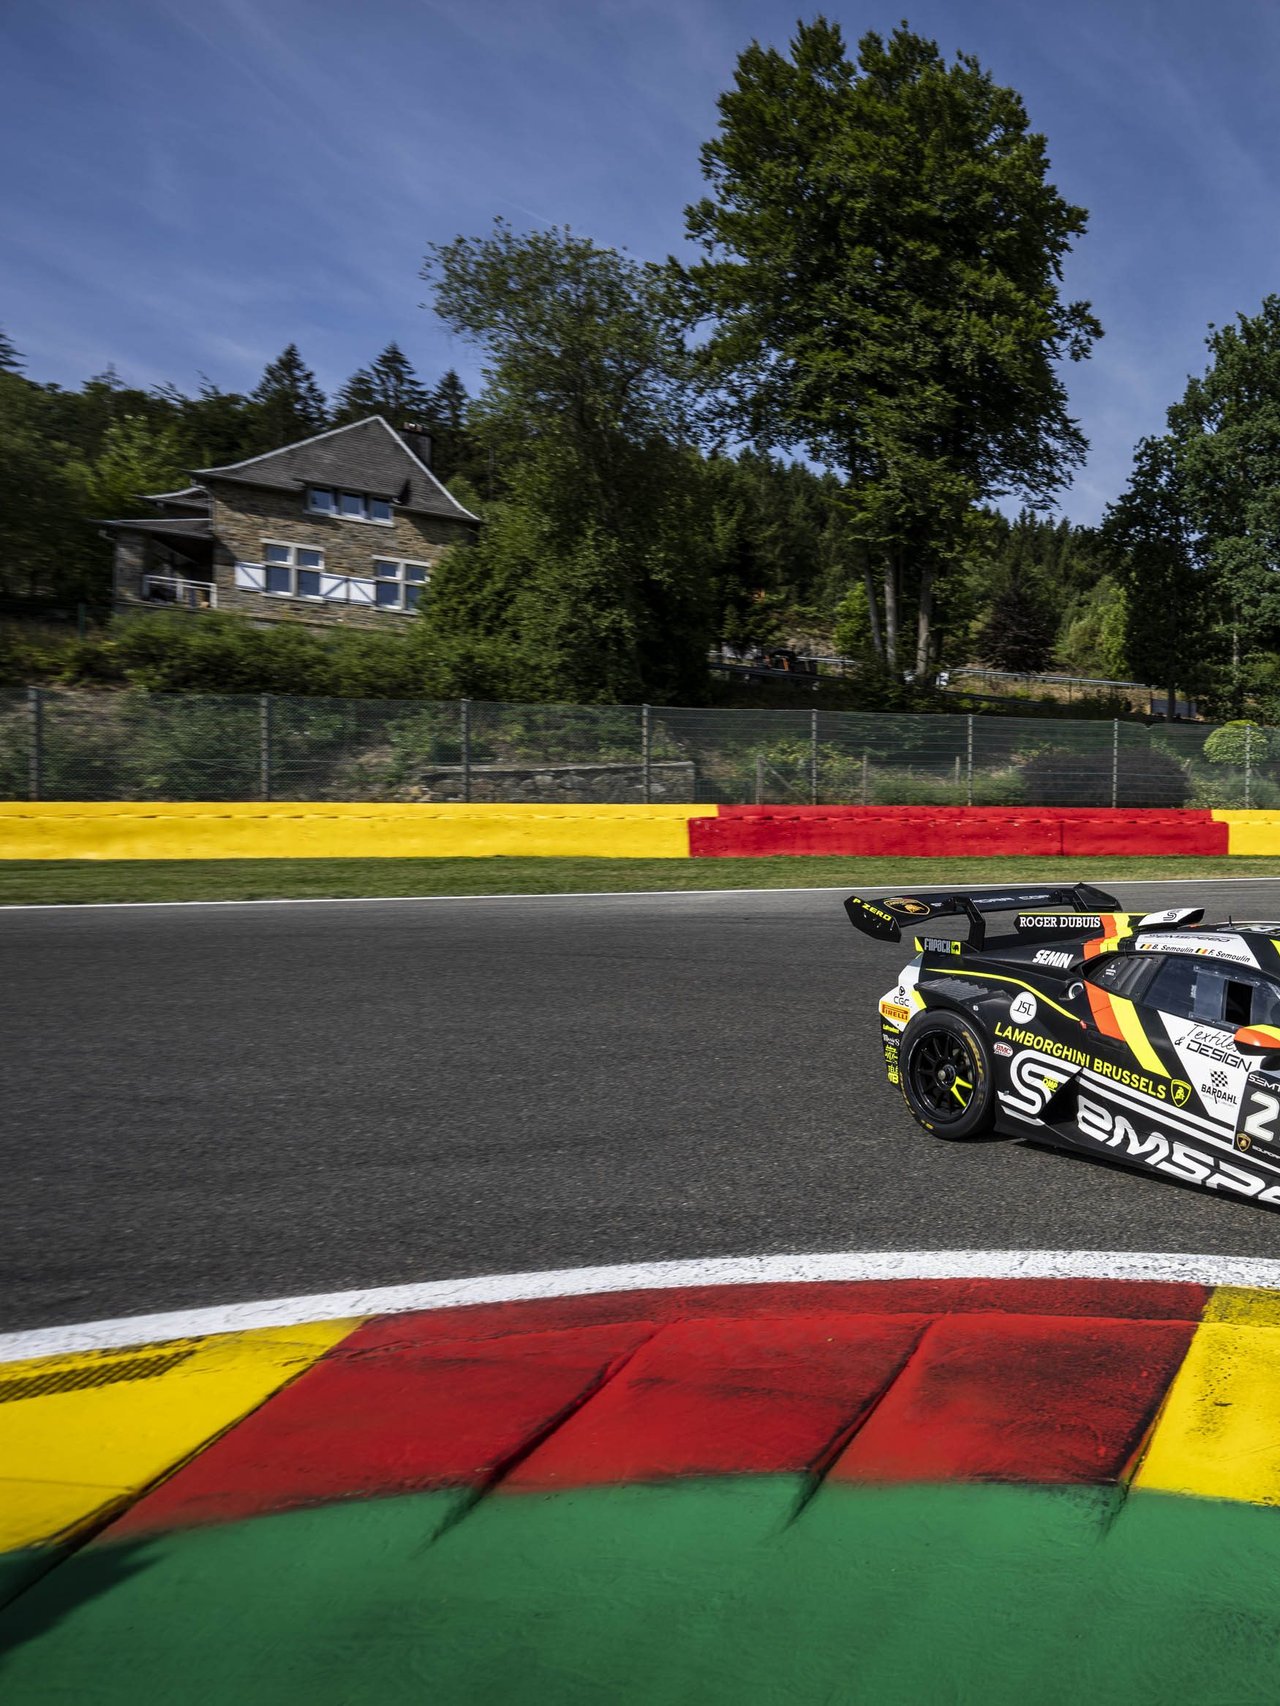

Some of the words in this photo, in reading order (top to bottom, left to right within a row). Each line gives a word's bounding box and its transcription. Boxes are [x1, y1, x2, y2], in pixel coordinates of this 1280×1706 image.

[861, 903, 892, 922] ZERO
[1019, 916, 1058, 928] ROGER
[1060, 916, 1101, 928] DUBUIS
[1160, 944, 1195, 953] Semoulin
[1216, 950, 1251, 963] Semoulin
[1032, 949, 1074, 969] SEMIN
[881, 1003, 909, 1021] PIRELLI
[1186, 1023, 1236, 1052] Textile
[994, 1022, 1090, 1068] LAMBORGHINI
[1093, 1058, 1167, 1099] BRUSSELS
[1174, 1037, 1182, 1046] &
[1186, 1039, 1252, 1072] DESIGN
[1201, 1084, 1238, 1105] BARDAHL
